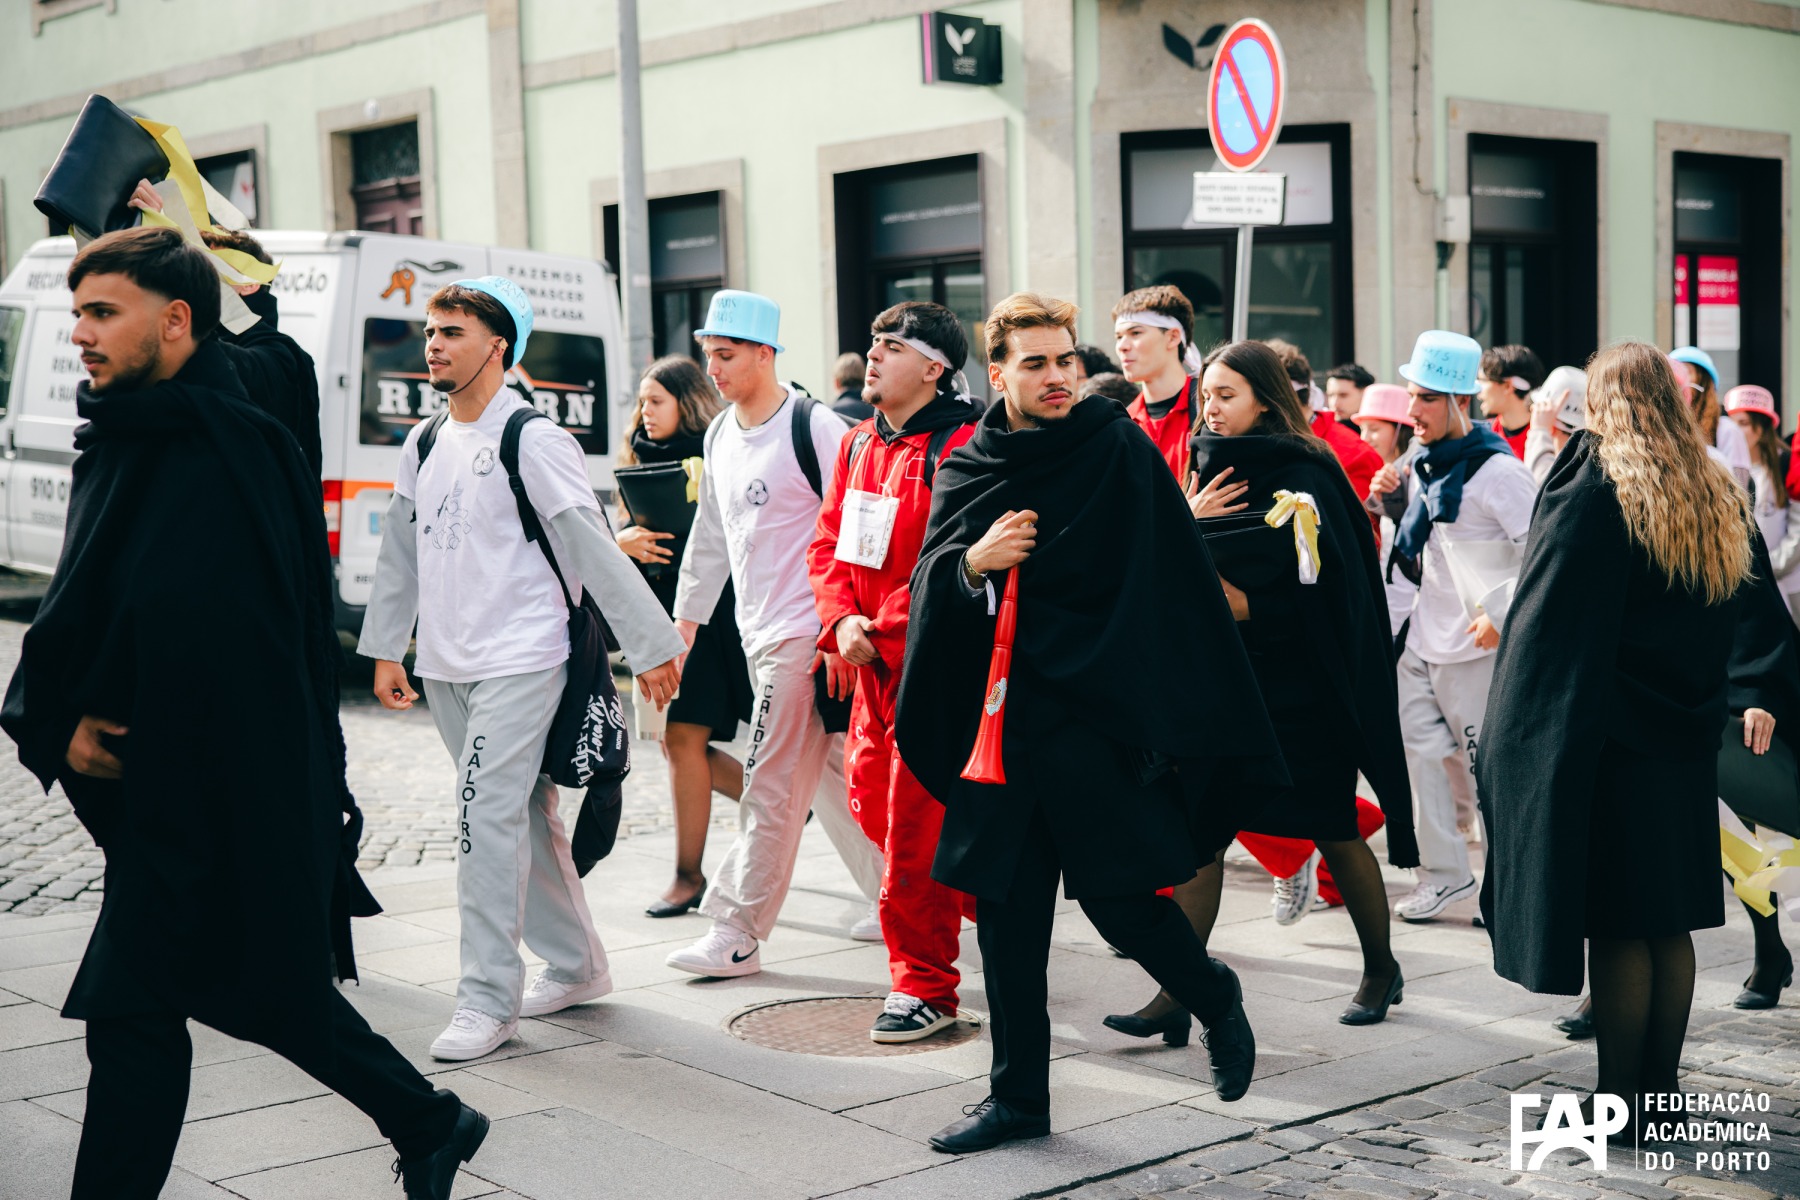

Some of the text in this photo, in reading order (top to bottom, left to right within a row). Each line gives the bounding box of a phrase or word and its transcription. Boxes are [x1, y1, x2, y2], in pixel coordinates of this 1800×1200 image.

[508, 265, 584, 285] FAZEMOS
[551, 306, 586, 321] CASA
[31, 475, 54, 501] 910
[460, 735, 486, 855] CALOIRO
